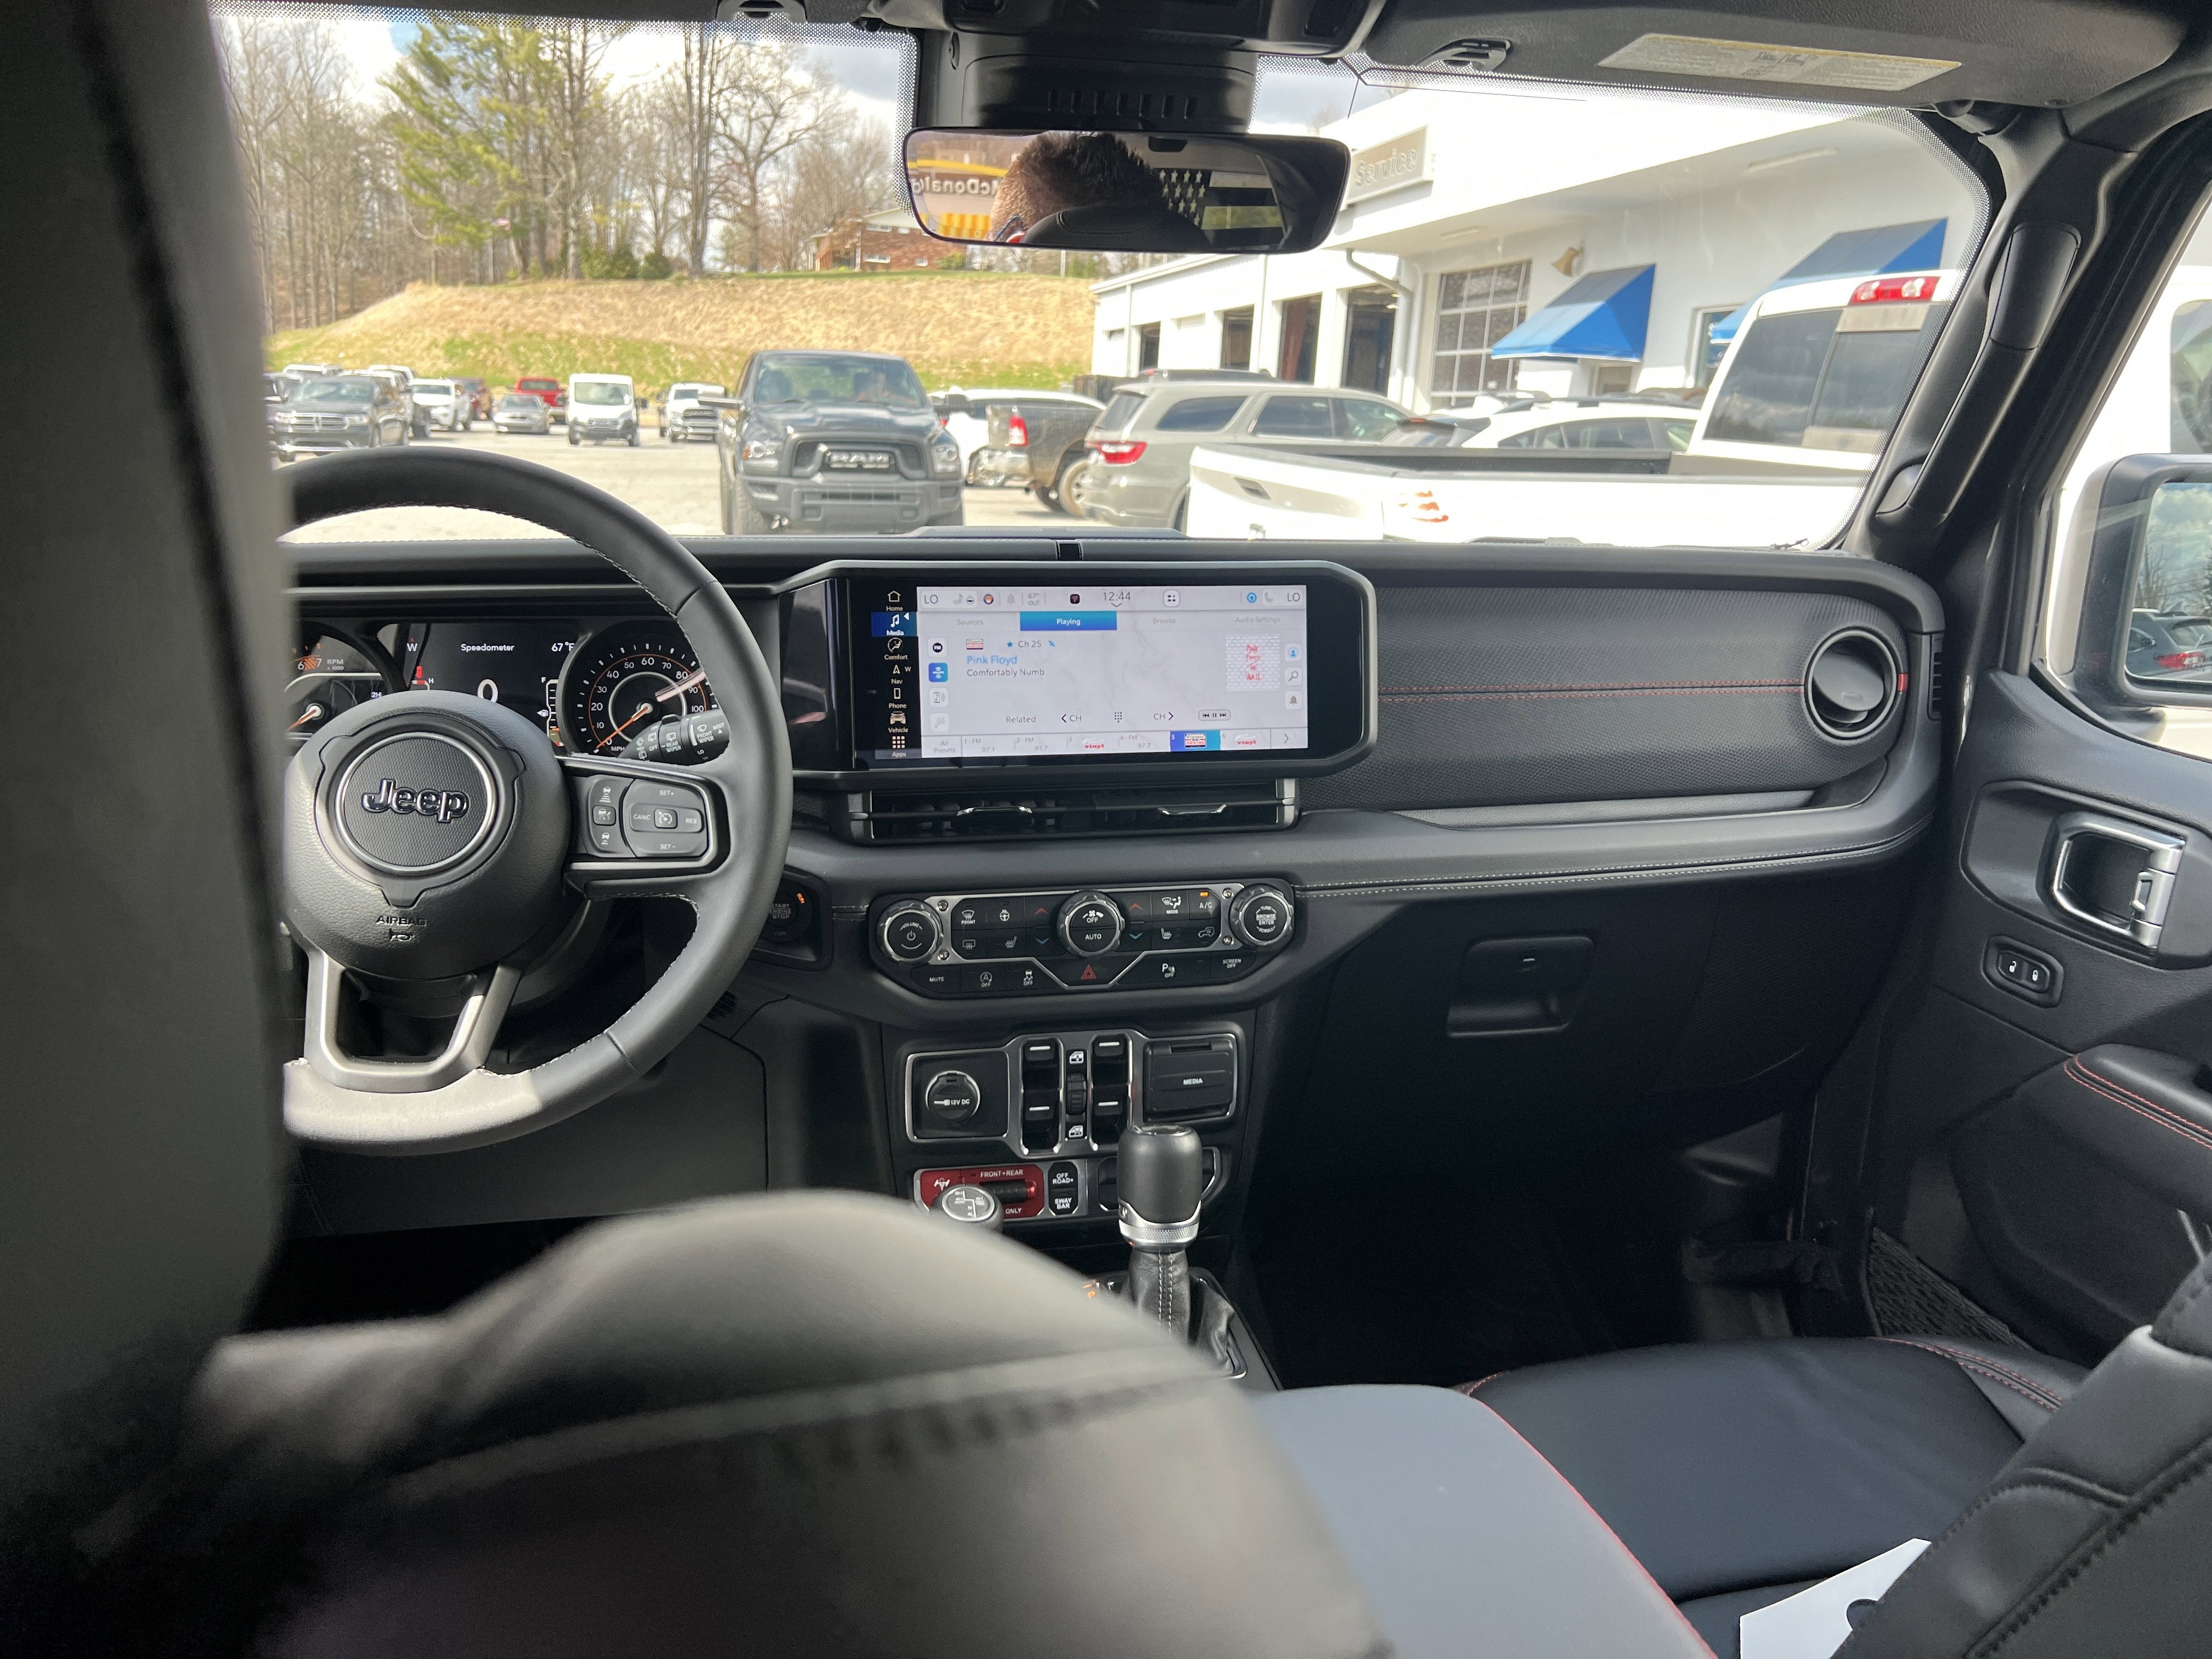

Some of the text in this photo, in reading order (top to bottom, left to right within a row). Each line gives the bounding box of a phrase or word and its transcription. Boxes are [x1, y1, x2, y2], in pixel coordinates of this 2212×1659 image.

[1355, 149, 1418, 187] Service
[924, 595, 938, 604] LO
[1103, 592, 1131, 601] 12:44
[1288, 593, 1300, 602] LO
[1057, 618, 1081, 627] Playing
[407, 643, 417, 651] W
[461, 644, 515, 652] Speedometer
[967, 656, 1018, 666] Pink Floyd
[297, 662, 304, 670] 6
[967, 669, 1017, 677] Comfortably
[362, 778, 470, 823] Jeep
[376, 915, 427, 927] AIRBAG
